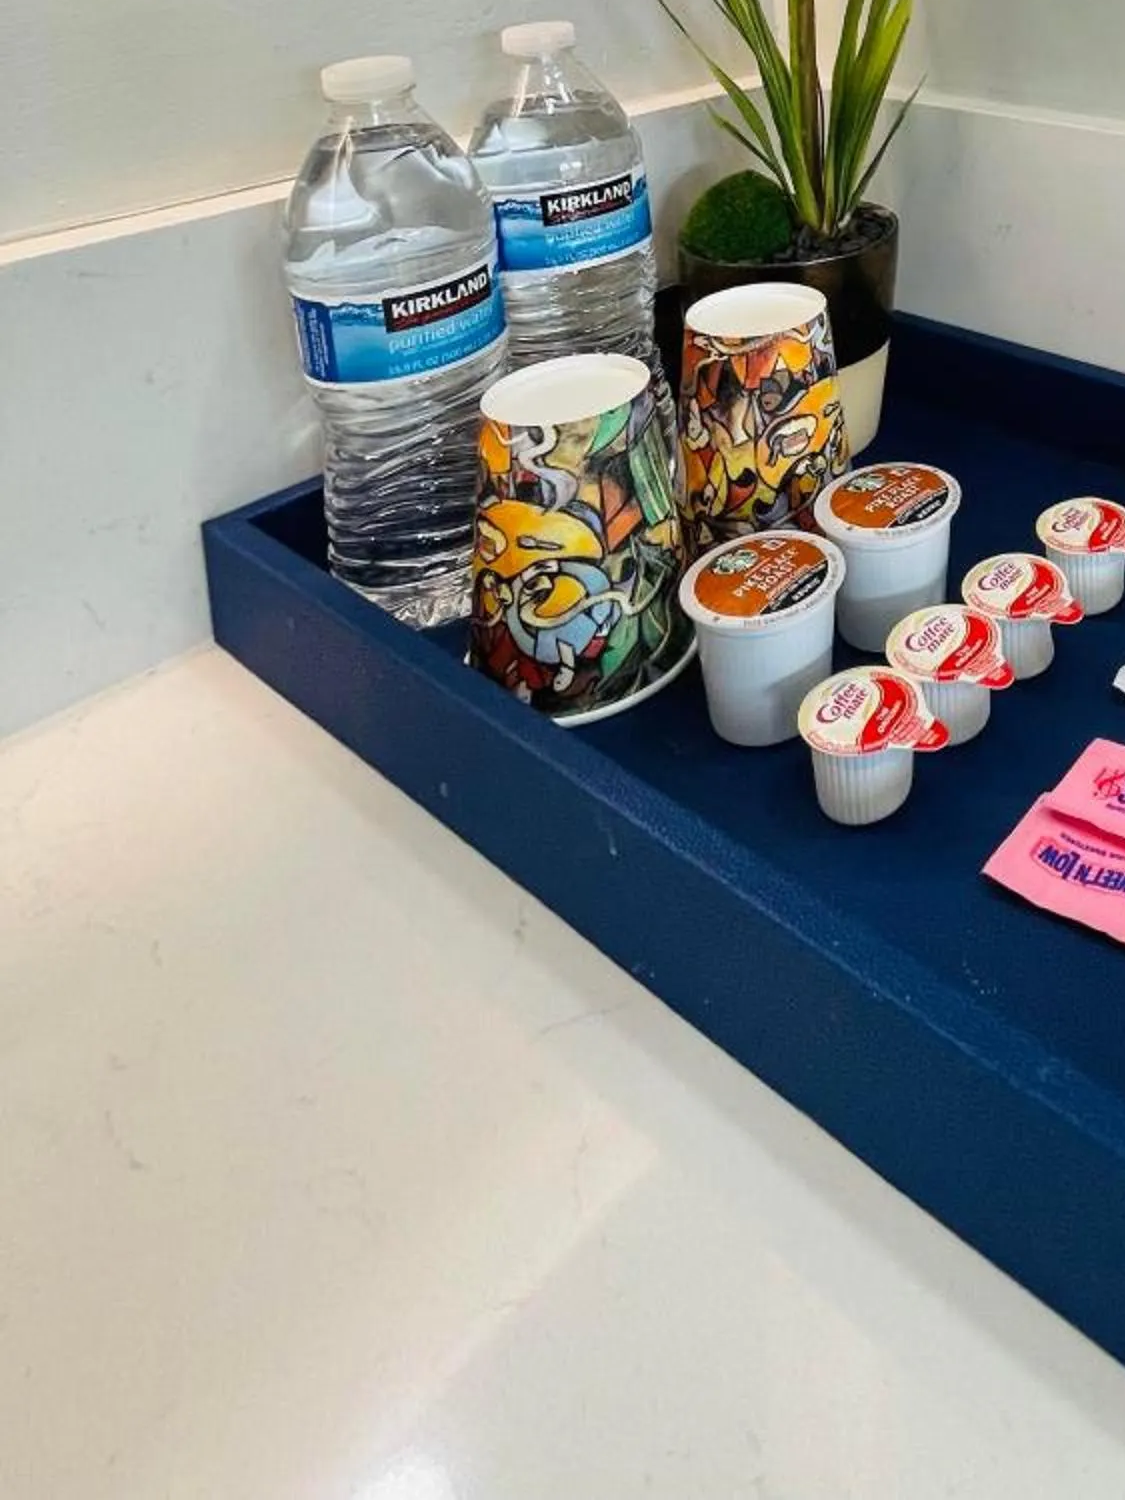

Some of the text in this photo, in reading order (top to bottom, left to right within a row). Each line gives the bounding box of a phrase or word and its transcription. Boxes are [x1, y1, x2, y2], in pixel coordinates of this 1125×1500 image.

[547, 180, 632, 217] KIRKLAND
[390, 270, 488, 319] KIRKLAND
[388, 323, 456, 355] purified
[978, 562, 1016, 591] Coffee
[905, 616, 949, 652] Coffee
[815, 682, 859, 724] Coffee
[843, 687, 869, 719] mate
